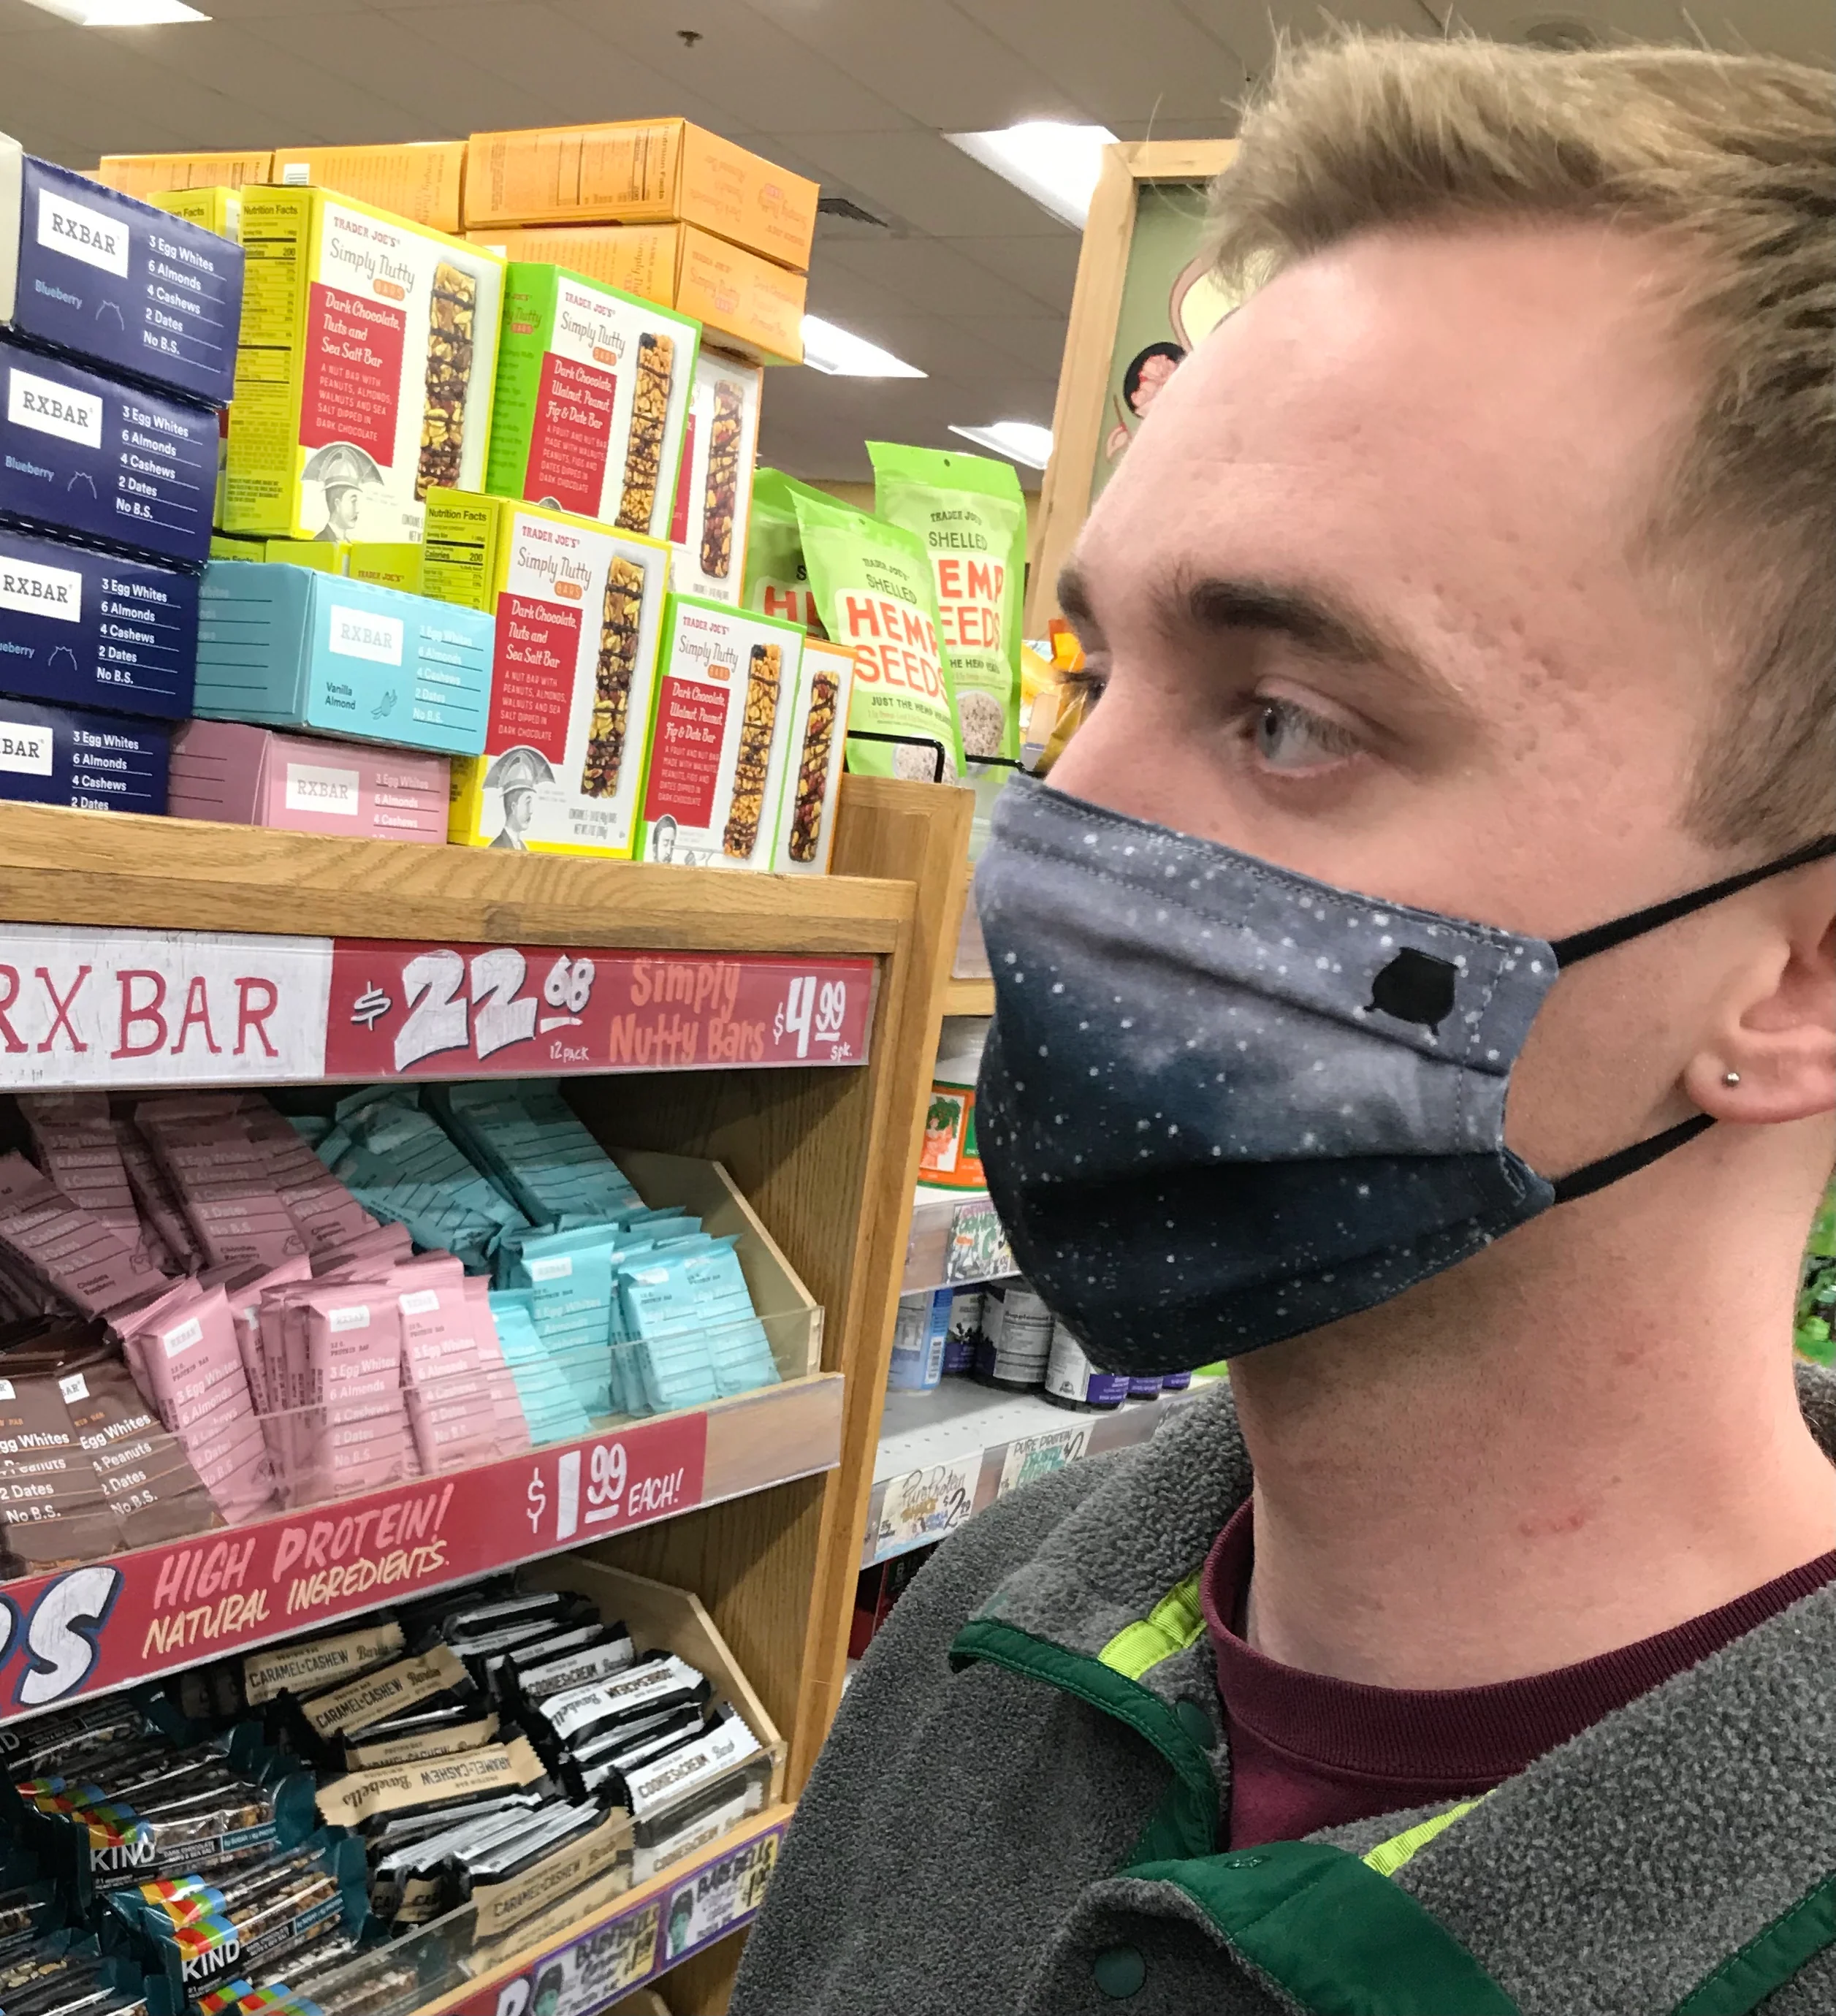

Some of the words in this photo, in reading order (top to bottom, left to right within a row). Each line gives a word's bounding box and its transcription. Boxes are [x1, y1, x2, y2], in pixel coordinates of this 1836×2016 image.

[243, 205, 273, 215] Nutrition
[276, 205, 297, 215] Facts
[52, 213, 115, 255] RXBAR
[334, 216, 368, 238] TRADER
[159, 238, 177, 258] Egg
[179, 246, 214, 272] Whites
[330, 238, 376, 281] Simply
[380, 254, 414, 293] Nutty
[157, 263, 201, 291] Almonds
[36, 280, 82, 310] Blueberry
[156, 287, 200, 314] Cashews
[565, 292, 591, 310] TRADER
[594, 303, 612, 317] JOE'S
[155, 311, 183, 331] Dates
[325, 291, 350, 314] Dark
[352, 302, 400, 331] Chocolate,
[324, 314, 346, 335] Nuts
[349, 322, 367, 341] and
[561, 311, 596, 348] Simply
[598, 324, 625, 359] Nutty
[144, 331, 158, 346] No
[161, 337, 180, 354] B.S.
[321, 337, 340, 356] Sea
[342, 342, 363, 363] Salt
[365, 349, 382, 368] Bar
[555, 360, 574, 378] Dark
[576, 368, 612, 392] Chocolate,
[23, 390, 88, 427] RXBAR
[318, 403, 335, 416] SALT
[319, 389, 354, 408] WALNUTS
[132, 409, 151, 427] Egg
[153, 415, 188, 437] Whites
[546, 402, 560, 422] Fig
[569, 407, 586, 425] Date
[588, 413, 603, 430] Bar
[338, 422, 377, 441] CHOCOLATE
[132, 433, 176, 456] Almonds
[6, 455, 54, 482] Blueberry
[130, 455, 175, 479] Cashews
[129, 478, 157, 497] Dates
[116, 498, 130, 512] No
[134, 503, 153, 519] B.S.
[429, 509, 461, 519] Nutrition
[463, 511, 487, 521] Facts
[522, 525, 552, 544] TRADER
[555, 534, 576, 548] JOE'S
[929, 532, 988, 551] SHELLED
[470, 552, 482, 561] 200
[518, 547, 558, 582] Simply
[560, 557, 592, 590] Nutty
[4, 574, 68, 603] RXBAR
[112, 580, 130, 597] Egg
[133, 585, 167, 602] Whites
[866, 574, 917, 604] SHELLED
[939, 559, 1004, 604] EMP
[111, 603, 155, 621] Almonds
[511, 599, 534, 620] Dark
[536, 604, 577, 629] Chocolate,
[110, 625, 154, 644] Cashews
[508, 622, 530, 640] Nuts
[531, 630, 548, 643] and
[683, 617, 704, 631] TRADER
[939, 606, 999, 650] EEDS
[340, 624, 392, 648] RXBAR
[443, 632, 472, 647] Whites
[109, 647, 137, 663] Dates
[427, 648, 461, 664] Almonds
[506, 644, 522, 661] Sea
[524, 647, 542, 665] Salt
[544, 650, 560, 669] Bar
[679, 635, 711, 669] Simply
[713, 647, 739, 672] Nutty
[97, 667, 111, 680] No
[114, 672, 133, 684] B.S.
[424, 669, 460, 685] Cashews
[511, 672, 525, 681] NUT
[527, 675, 538, 684] BAR
[541, 677, 557, 687] WITH
[327, 682, 352, 696] Vanilla
[423, 690, 446, 704] Dates
[503, 684, 534, 697] PEANUTS,
[536, 690, 566, 703] ALMONDS,
[673, 682, 690, 699] Dark
[325, 696, 355, 710] Almond
[503, 697, 533, 710] WALNUTS
[535, 703, 547, 712] AND
[549, 704, 560, 714] SEA
[872, 696, 893, 707] JUST
[897, 699, 913, 709] THE
[500, 710, 516, 720] SALT
[518, 712, 539, 724] DIPPED
[83, 731, 102, 747] Egg
[103, 734, 139, 750] Whites
[498, 725, 516, 735] DARK
[518, 727, 552, 741] CHOCOLATE
[83, 754, 127, 769] Almonds
[82, 775, 126, 791] Cashews
[297, 780, 348, 799] RXBAR
[400, 777, 428, 789] Whites
[81, 797, 109, 810] Dates
[382, 795, 418, 809] Almonds
[382, 815, 417, 829] Cashews
[631, 956, 742, 1022] Simply
[110, 970, 278, 1060] BAR
[609, 1012, 698, 1064] Nutty
[708, 1017, 765, 1062] Bars
[422, 1344, 441, 1358] Egg
[443, 1338, 475, 1352] Whites
[340, 1364, 359, 1378] Egg
[362, 1357, 396, 1371] Whites
[185, 1381, 204, 1399] Egg
[204, 1359, 239, 1385] Whites
[340, 1380, 384, 1398] Almonds
[191, 1385, 232, 1418] Almonds
[18, 1433, 69, 1449] Whites
[80, 1431, 105, 1450] Egg
[108, 1415, 151, 1439] Whites
[1040, 1429, 1073, 1448] PROTEIN
[102, 1440, 152, 1468] Peanuts
[11, 1483, 53, 1497] Dates
[110, 1469, 146, 1491] Dates
[110, 1501, 131, 1515] No
[133, 1489, 158, 1509] B.S.
[628, 1467, 684, 1516] EACH!
[6, 1510, 28, 1524] No
[30, 1505, 61, 1519] B.S.
[153, 1537, 256, 1610] HIGH
[273, 1483, 455, 1583] PROTEIN!
[142, 1589, 270, 1659] NATURAL
[91, 1843, 155, 1871] KIND
[183, 1940, 240, 1982] KIND
